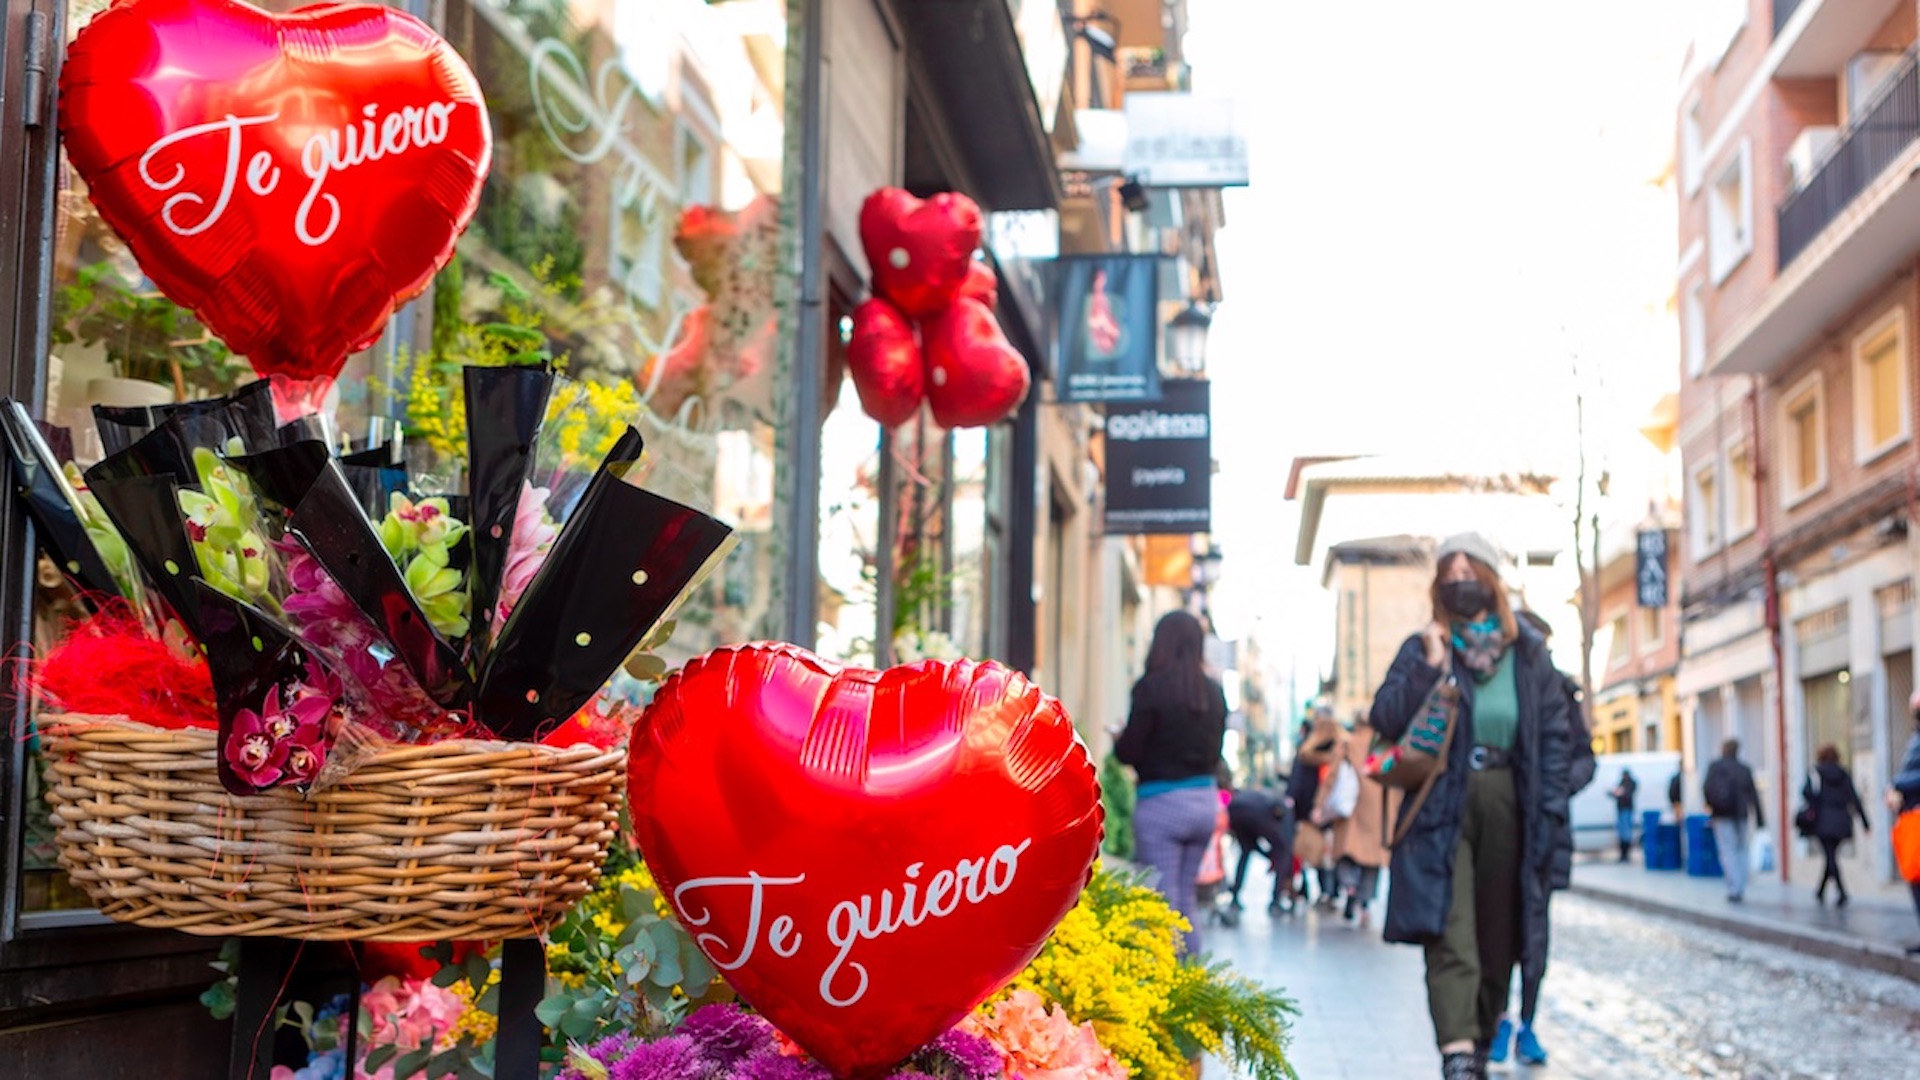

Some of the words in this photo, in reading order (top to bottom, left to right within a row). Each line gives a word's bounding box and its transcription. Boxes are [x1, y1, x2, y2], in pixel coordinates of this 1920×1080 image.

[138, 112, 281, 236] Te
[294, 101, 457, 246] quiero
[673, 870, 805, 971] Te
[819, 837, 1032, 1007] quiero
